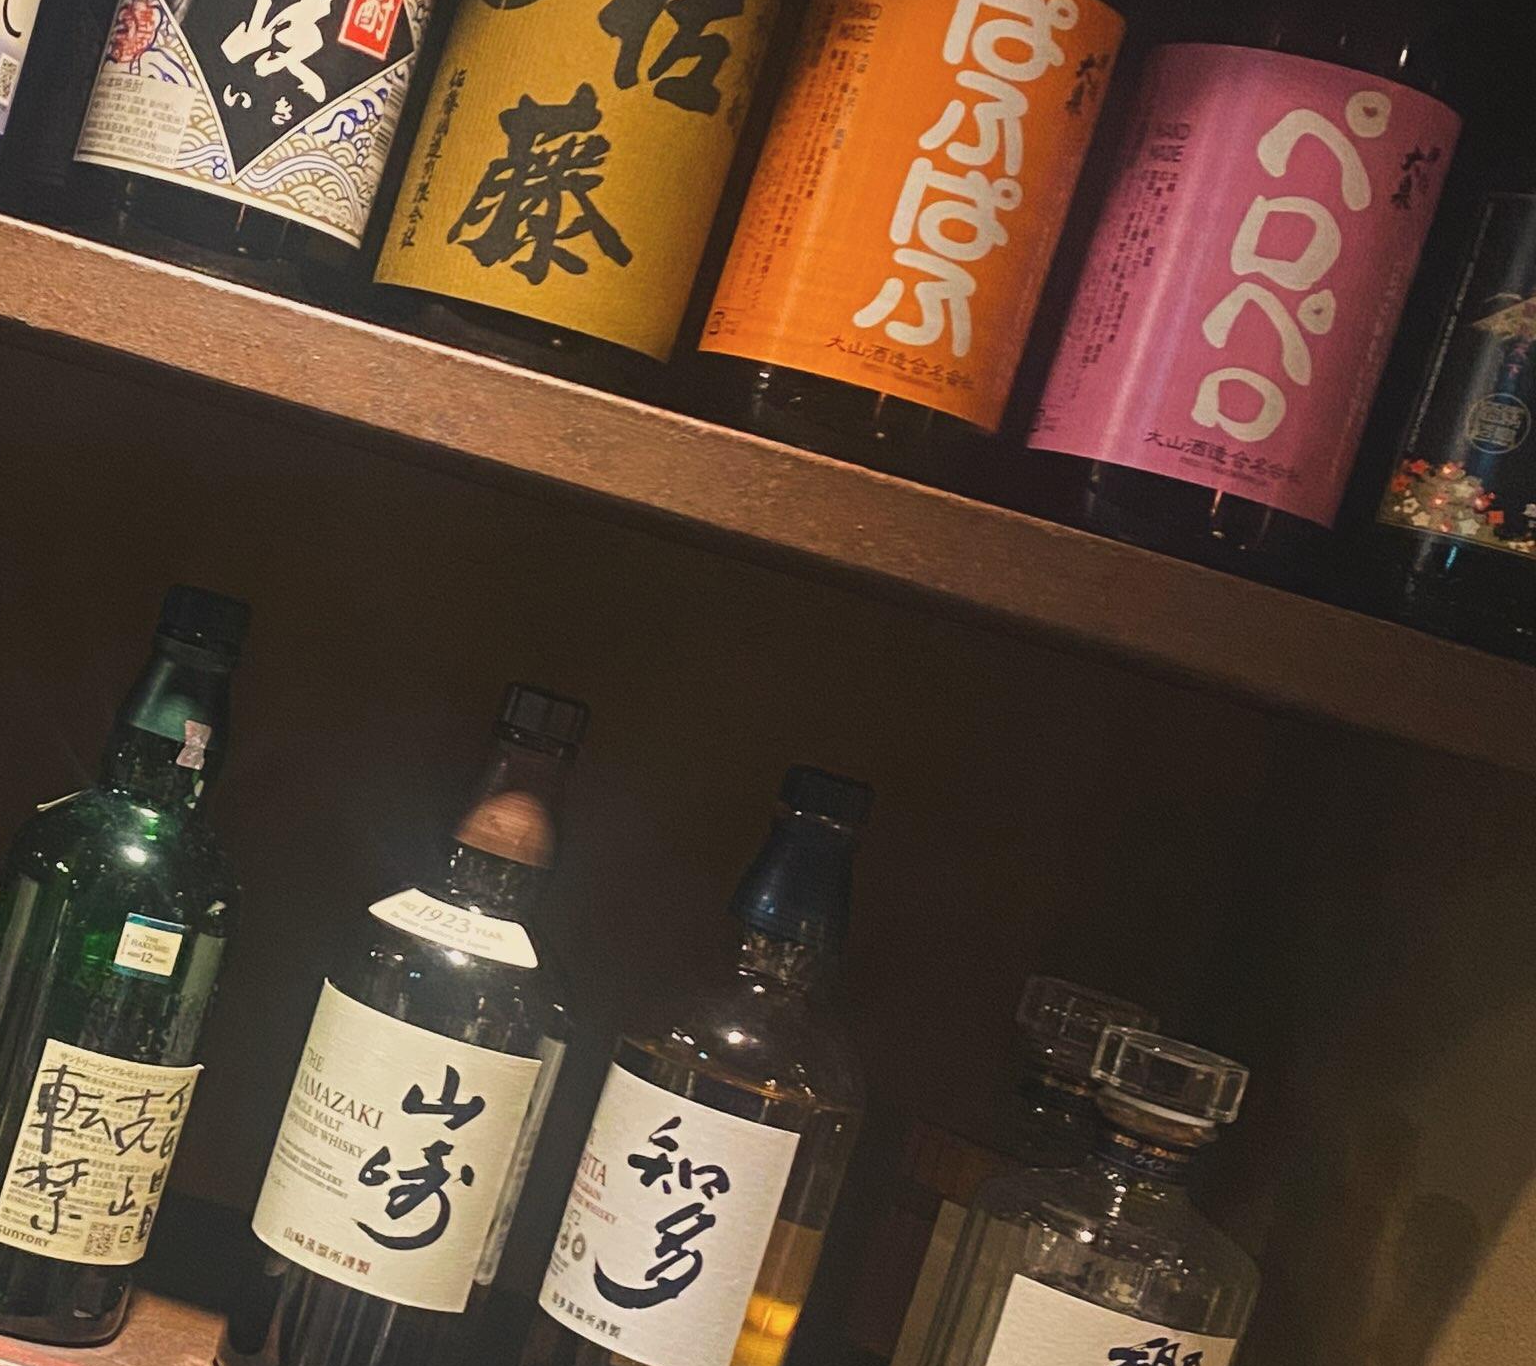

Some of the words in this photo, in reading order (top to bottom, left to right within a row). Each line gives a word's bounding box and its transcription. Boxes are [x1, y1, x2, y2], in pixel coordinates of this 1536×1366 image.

[416, 896, 472, 935] 1923
[319, 1122, 368, 1160] WHISKY
[350, 1064, 487, 1252] 山崎
[578, 1150, 609, 1188] HITA
[593, 1115, 731, 1311] 知多
